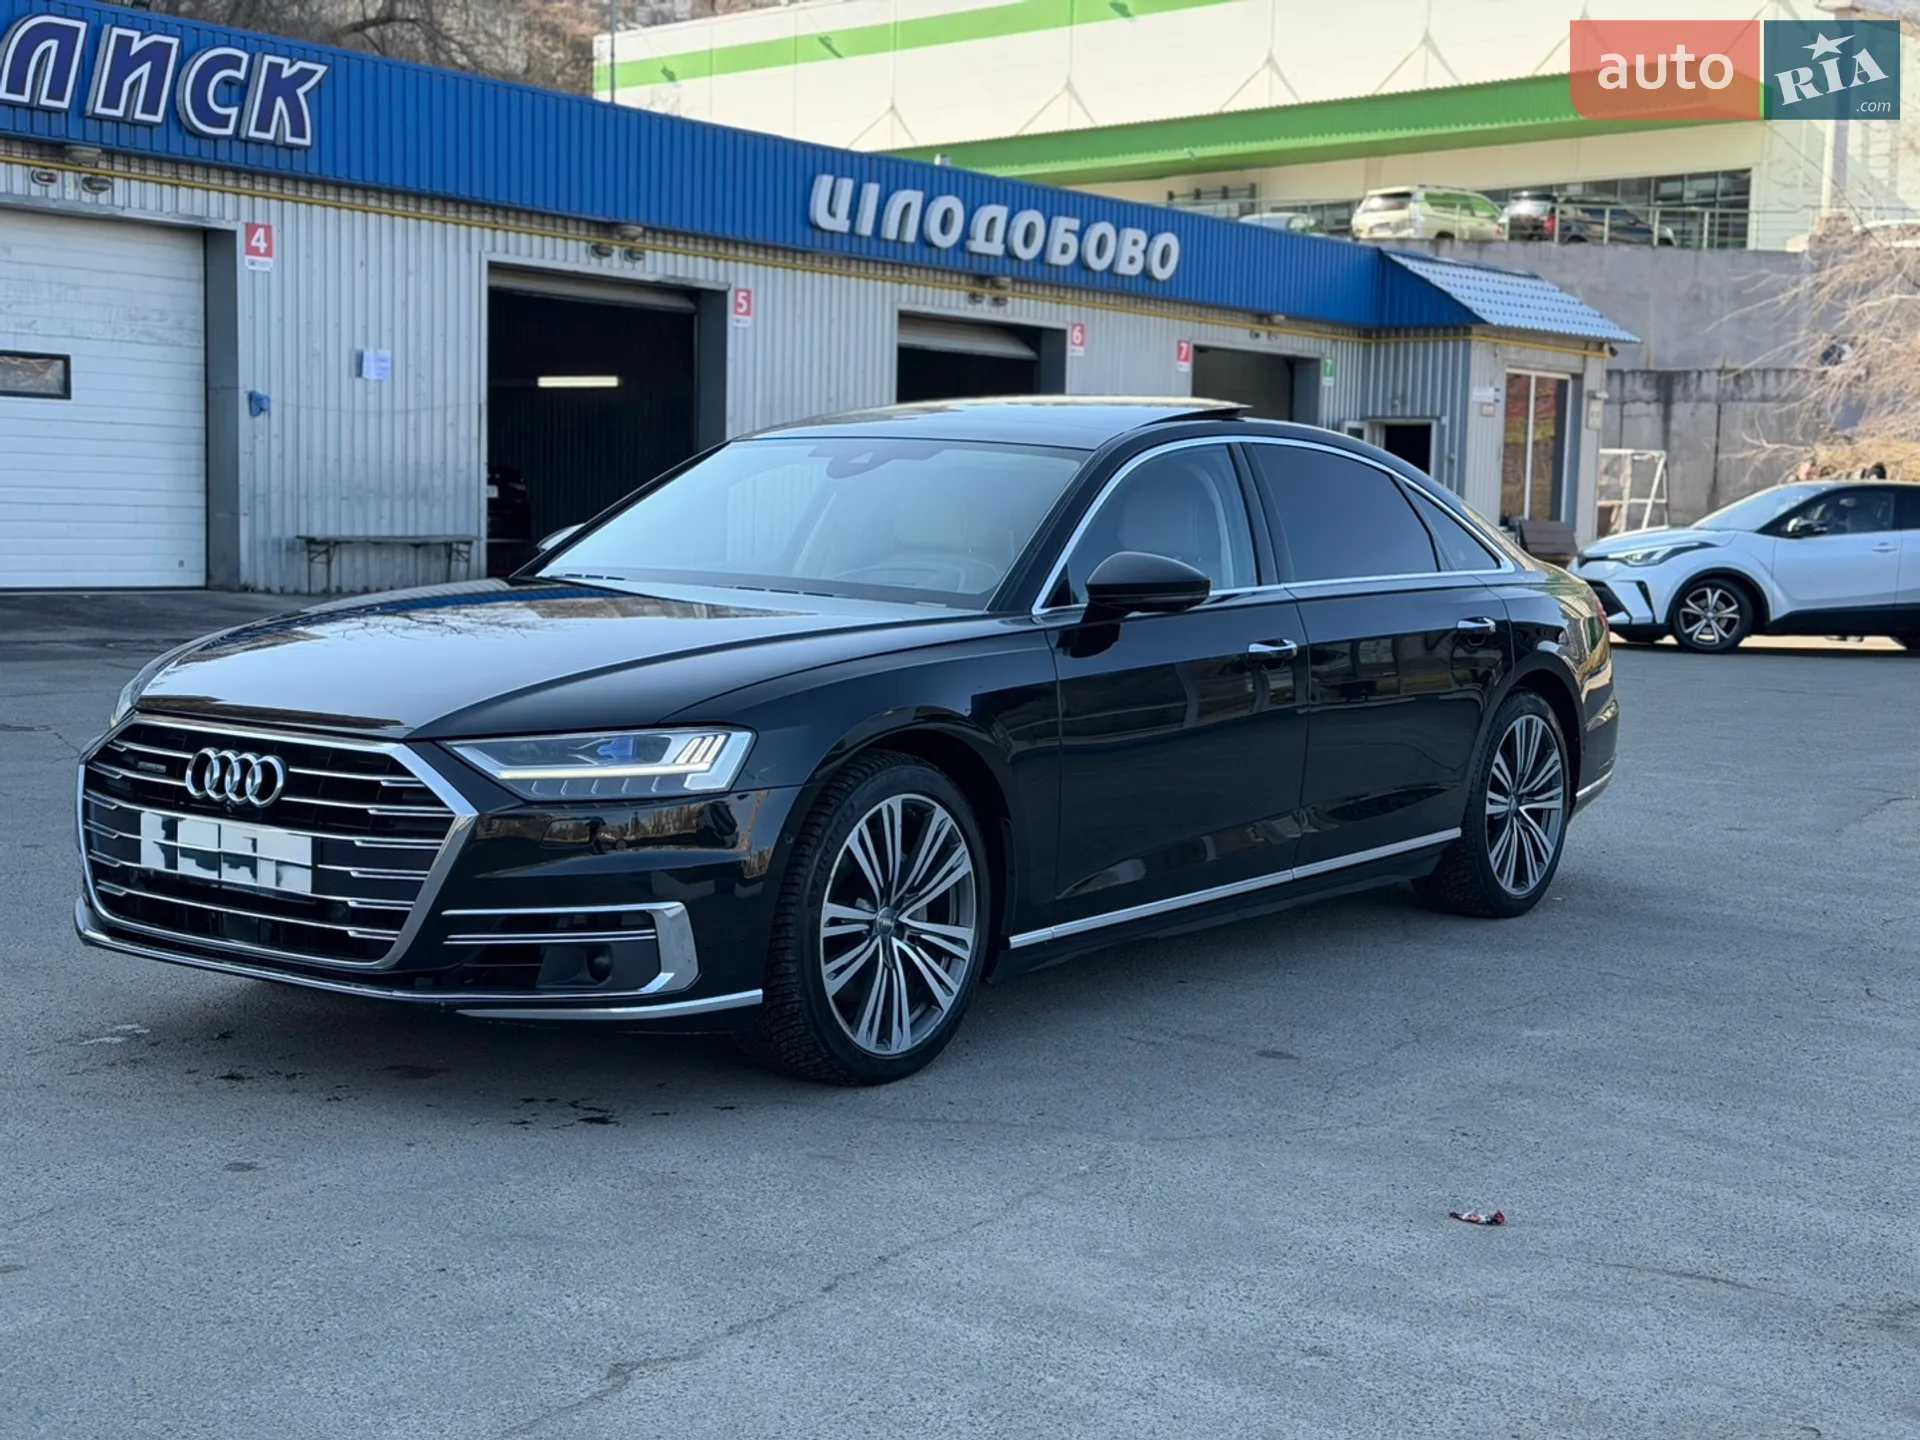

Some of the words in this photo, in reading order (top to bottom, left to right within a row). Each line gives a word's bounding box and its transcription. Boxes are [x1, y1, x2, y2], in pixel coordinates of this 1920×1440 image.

[0, 14, 329, 147] ЛИСК
[809, 174, 1180, 281] ЦІЛОДОБОВО
[251, 227, 268, 255] 4
[737, 290, 748, 314] 5
[1073, 325, 1082, 345] 6
[1179, 341, 1189, 360] 7
